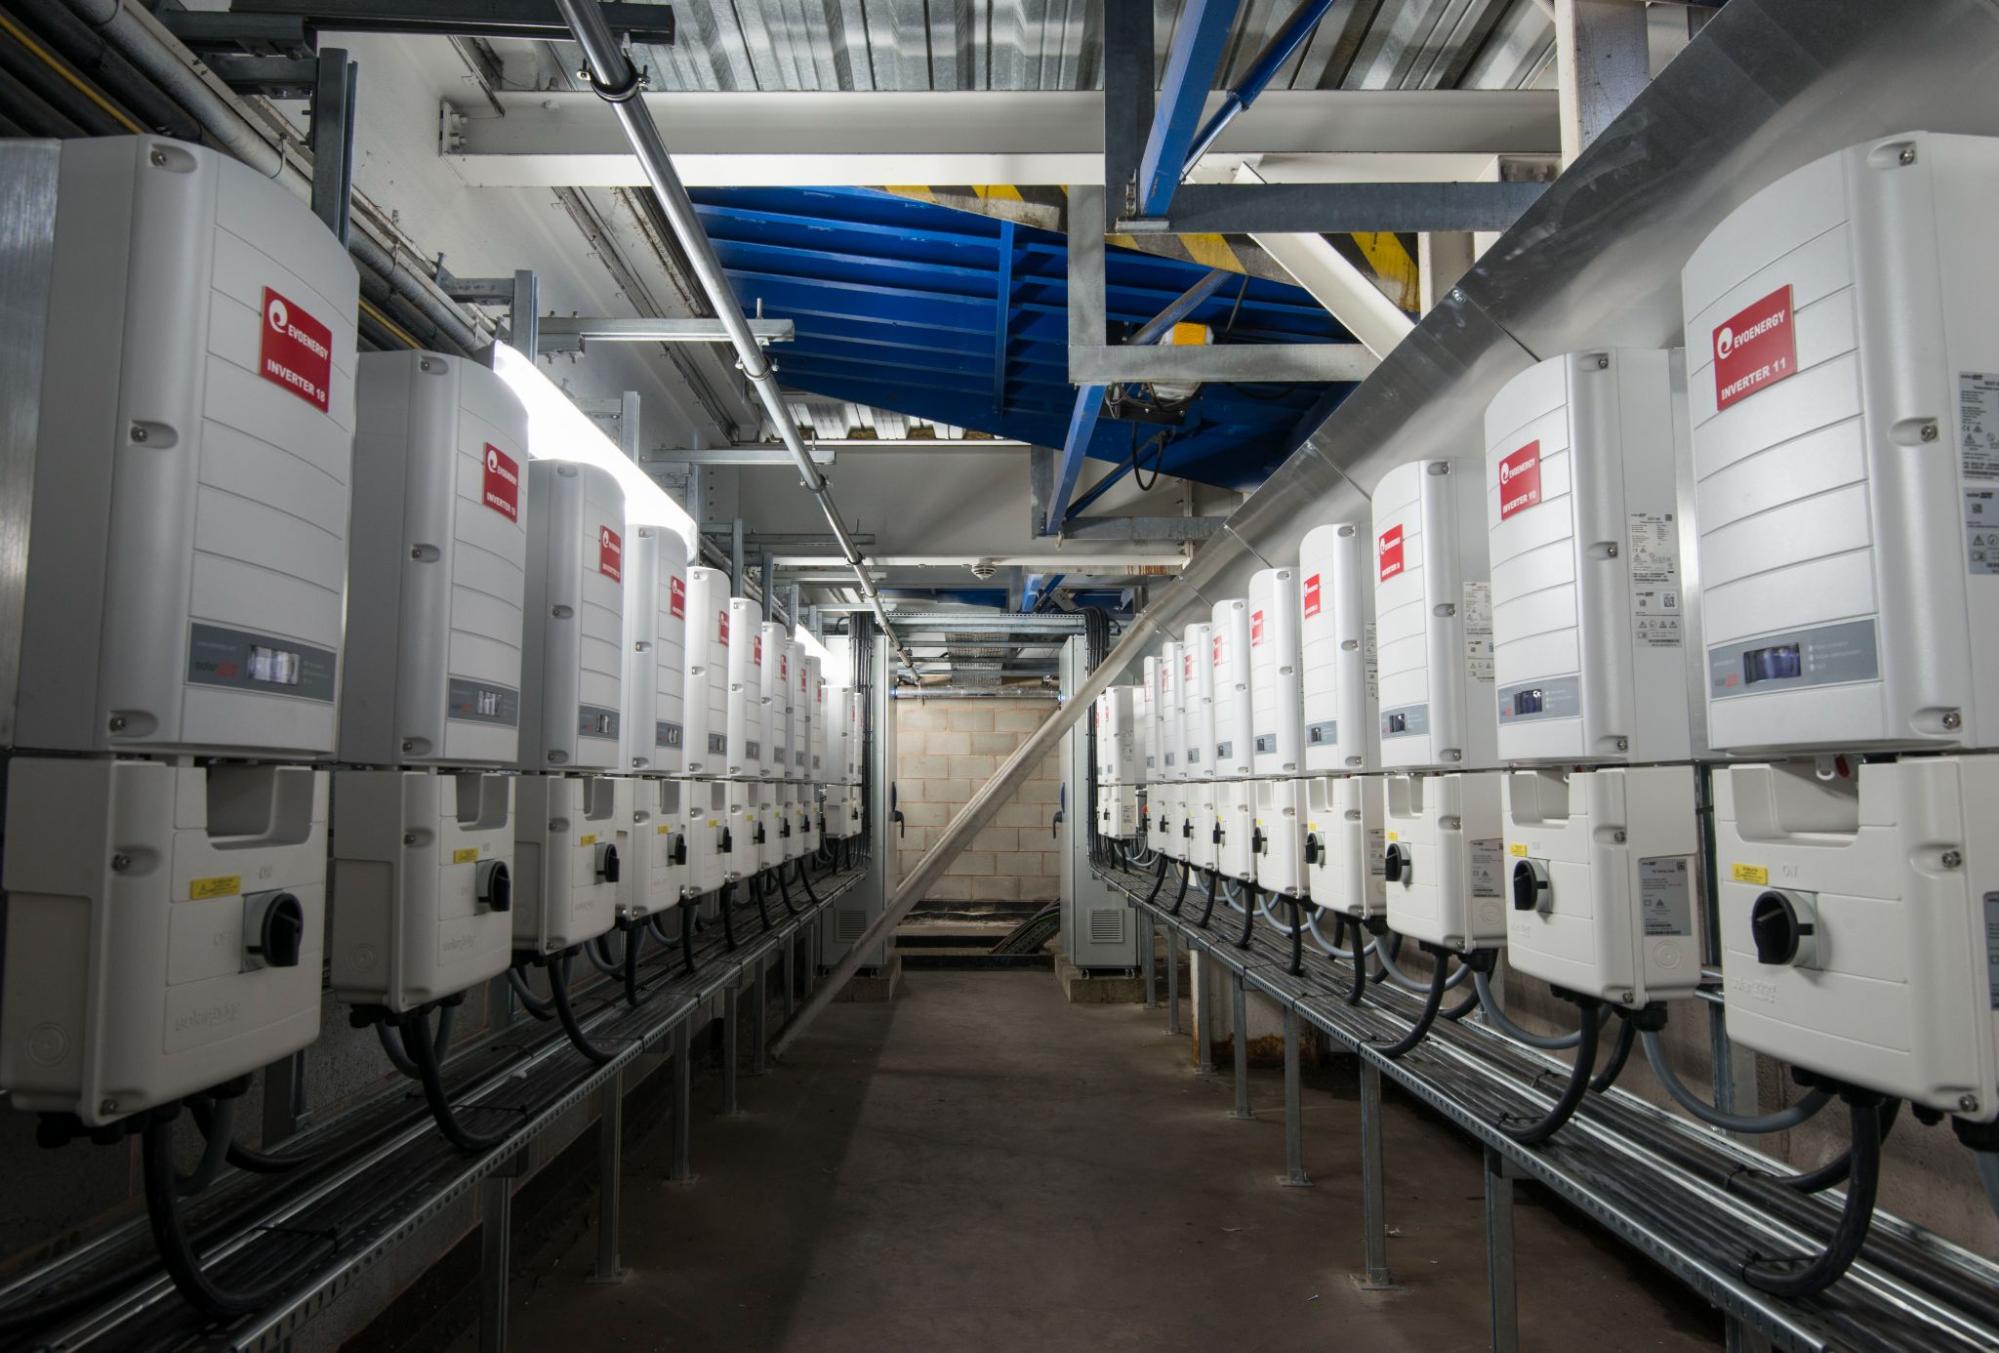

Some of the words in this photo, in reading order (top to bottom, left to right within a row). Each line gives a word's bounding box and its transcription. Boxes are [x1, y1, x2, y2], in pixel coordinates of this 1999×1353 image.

[288, 324, 328, 360] EVOENERGY
[1734, 310, 1785, 348] EVOENERGY
[267, 359, 315, 396] INVERTER
[1722, 366, 1770, 401] INVERTER
[1773, 357, 1786, 373] 11
